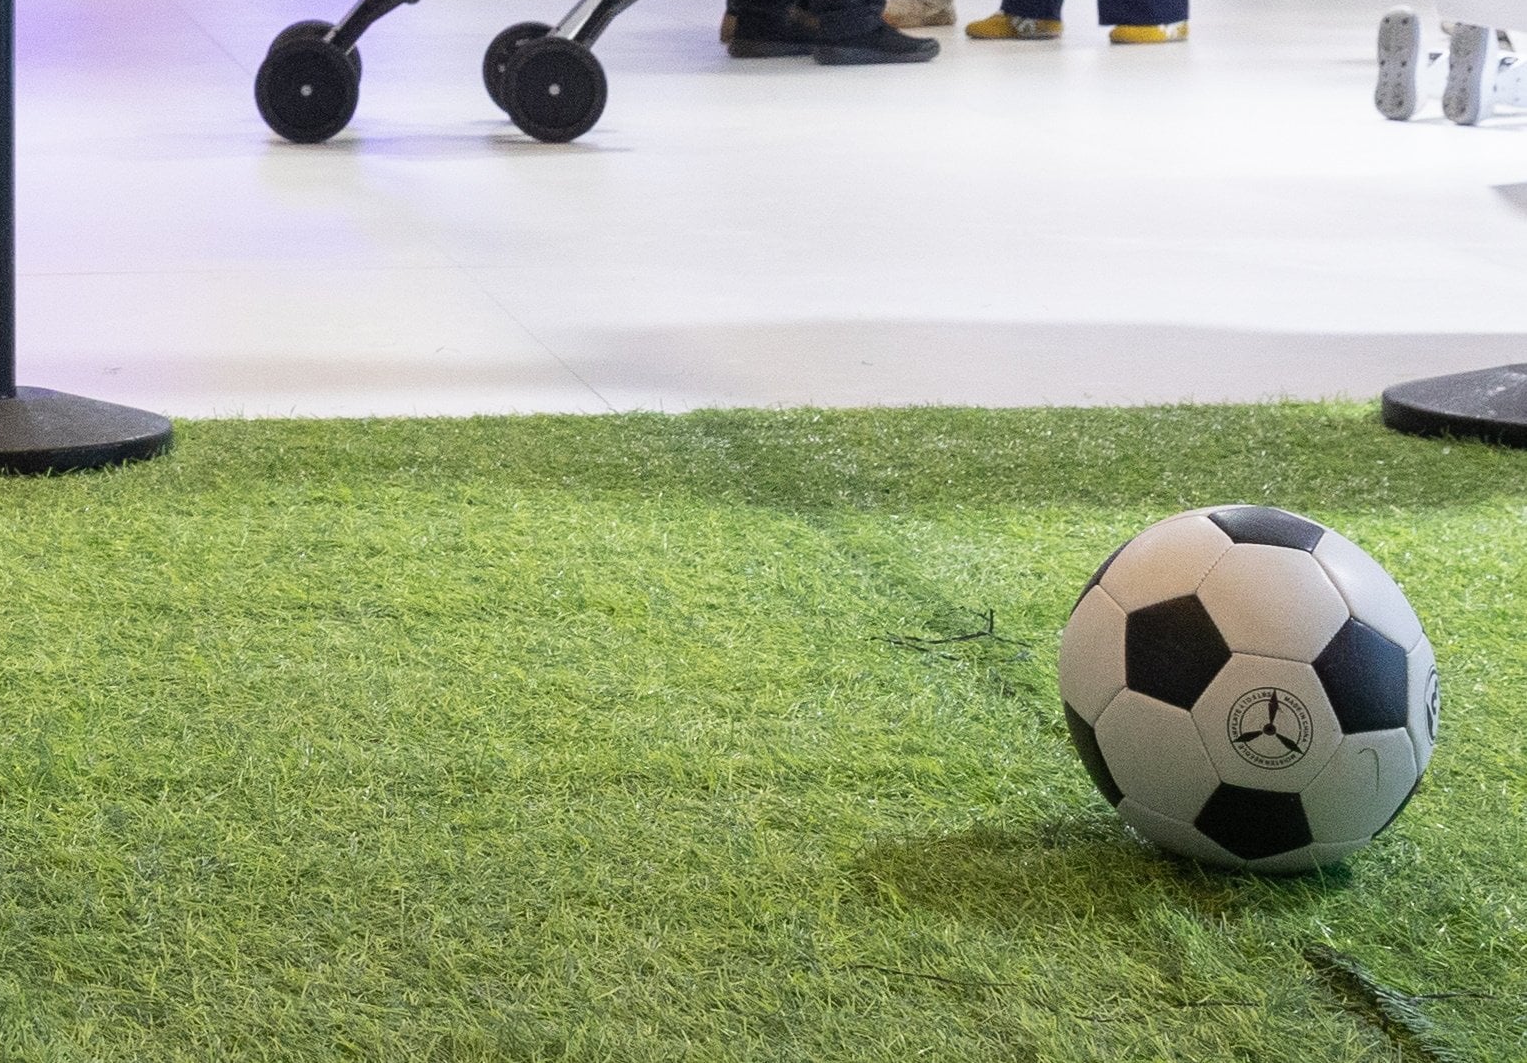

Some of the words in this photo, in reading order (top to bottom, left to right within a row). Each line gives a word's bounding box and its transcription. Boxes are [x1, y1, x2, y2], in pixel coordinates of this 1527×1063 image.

[1284, 696, 1302, 712] MADE
[1299, 711, 1307, 720] IN
[1302, 721, 1310, 743] CHINA
